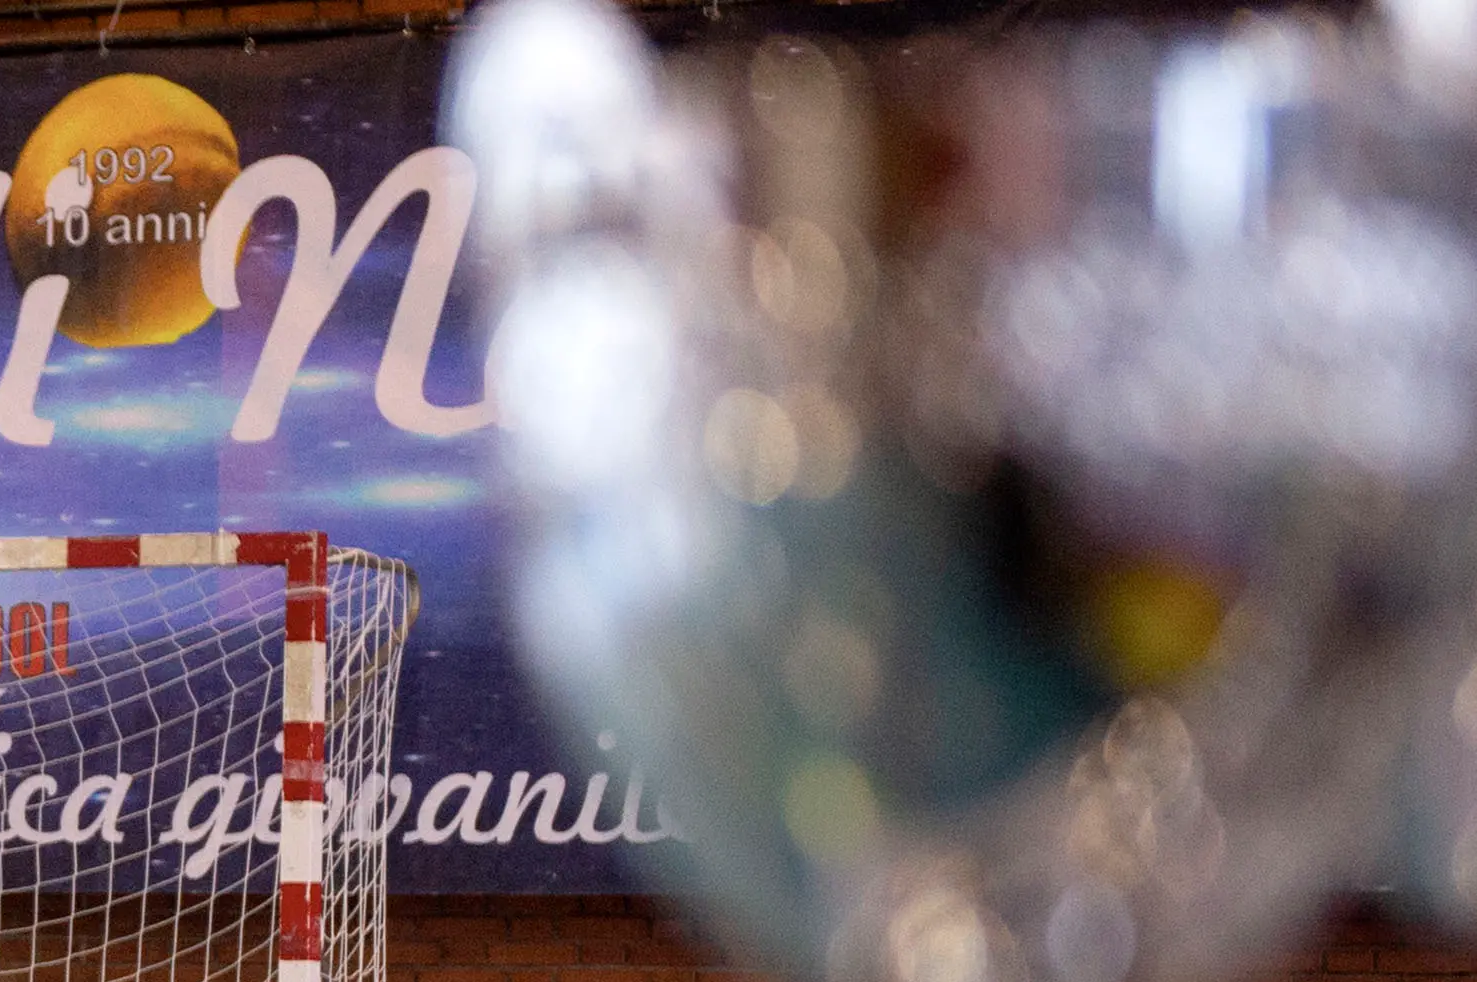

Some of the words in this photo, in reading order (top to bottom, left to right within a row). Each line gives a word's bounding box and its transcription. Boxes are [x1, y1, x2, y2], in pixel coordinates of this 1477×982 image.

[70, 144, 175, 186] 1992
[36, 206, 90, 247] 10
[105, 202, 206, 246] anni
